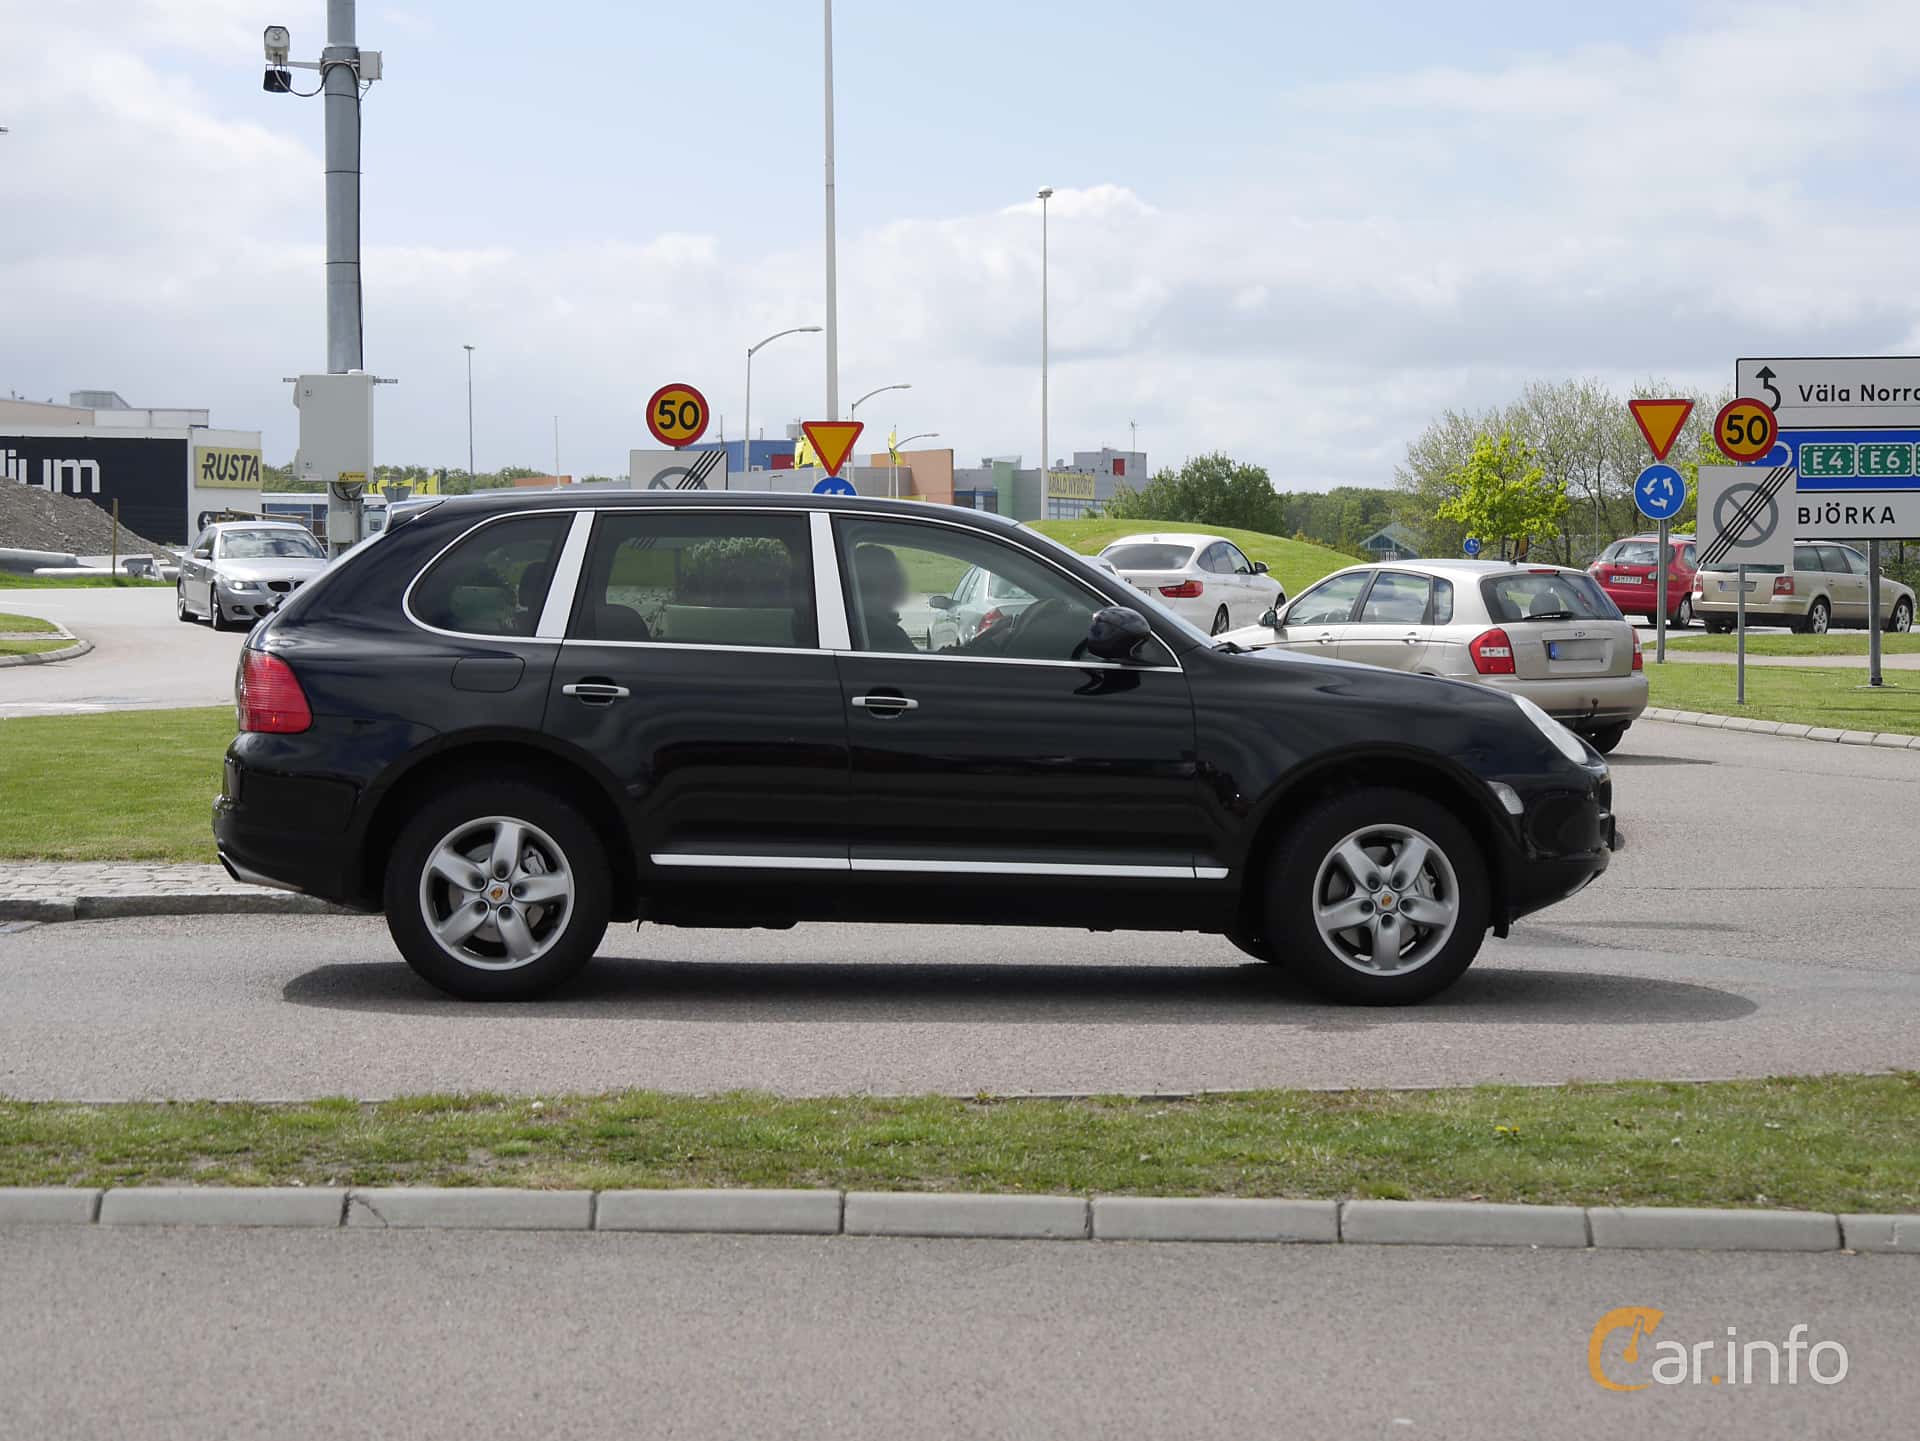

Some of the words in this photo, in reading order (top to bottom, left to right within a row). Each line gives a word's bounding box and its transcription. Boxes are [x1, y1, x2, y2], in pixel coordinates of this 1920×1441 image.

[1798, 384, 1850, 402] Väla
[658, 400, 700, 430] 50
[1726, 415, 1768, 445] 50
[0, 449, 100, 493] ium
[202, 453, 260, 481] RUSTA
[1812, 451, 1844, 469] E4
[1869, 450, 1901, 469] E6
[1797, 502, 1896, 524] BJÖRKA
